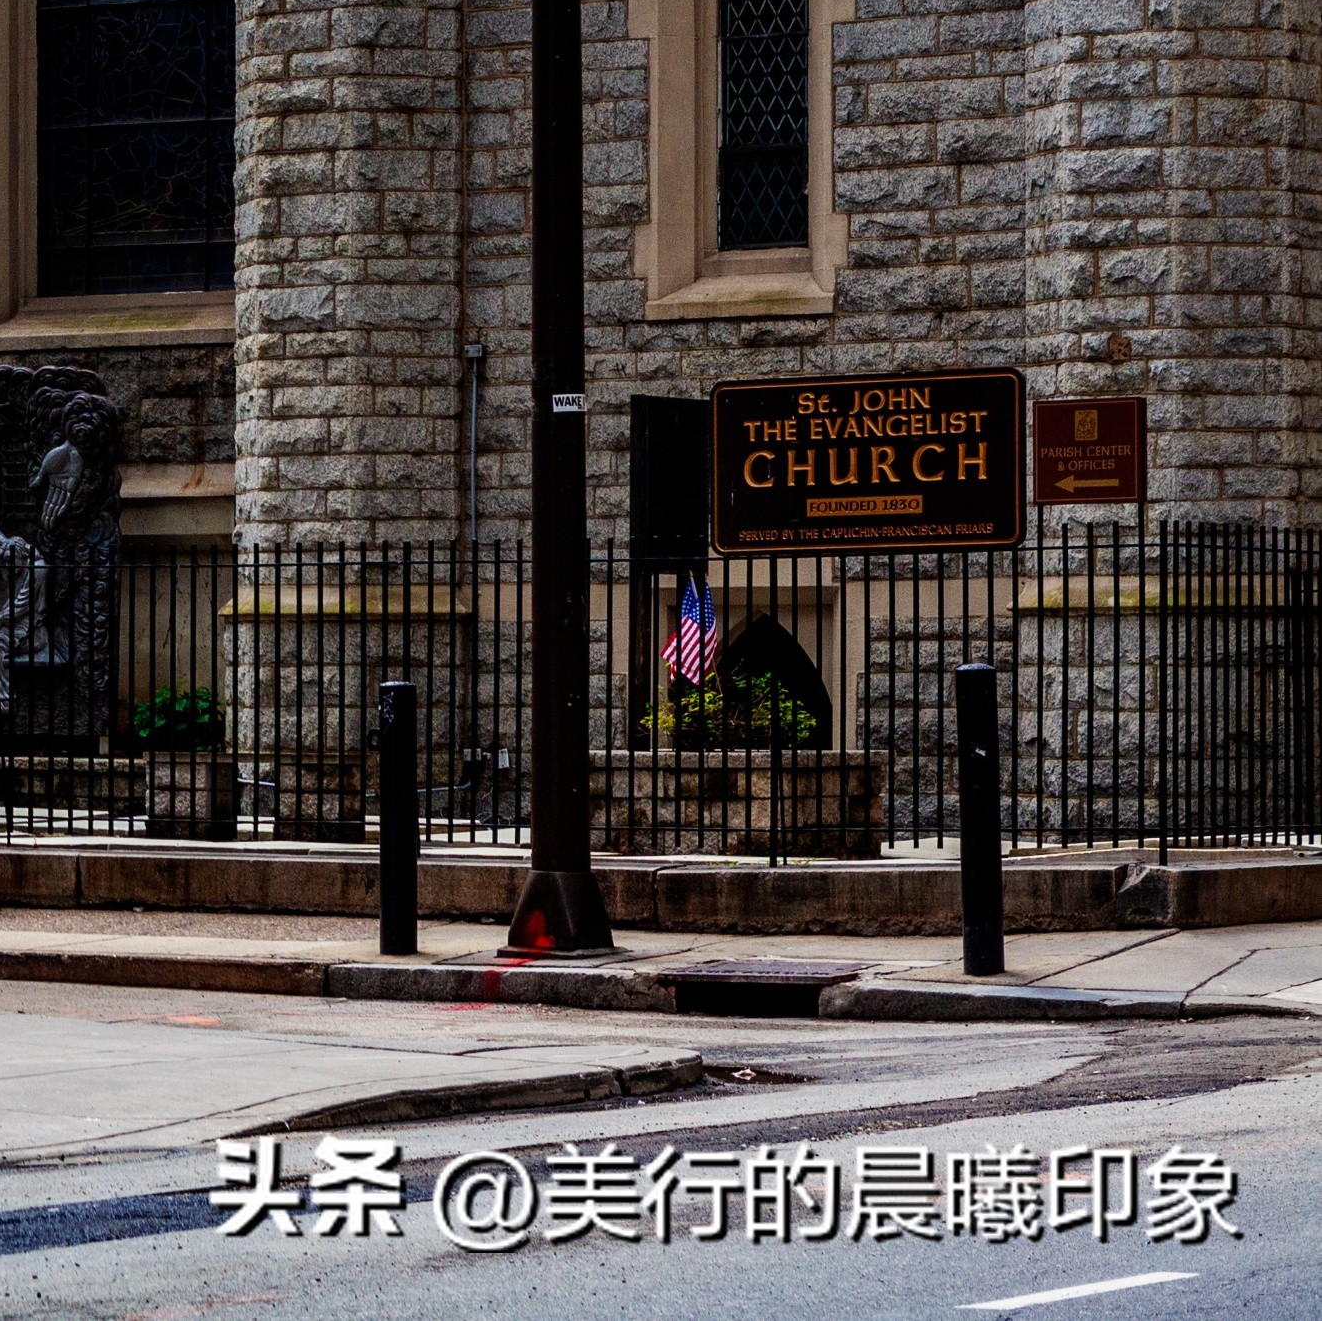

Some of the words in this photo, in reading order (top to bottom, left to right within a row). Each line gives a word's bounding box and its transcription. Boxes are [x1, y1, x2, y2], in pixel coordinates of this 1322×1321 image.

[797, 392, 838, 414] St.
[849, 387, 931, 415] JOHN
[743, 419, 798, 442] THE
[810, 410, 988, 440] EVANGELIST
[1040, 446, 1083, 458] PARISH
[1086, 444, 1131, 457] CENTER
[743, 442, 988, 488] CHURCH
[1057, 460, 1065, 471] &
[1068, 458, 1116, 471] OFFICES
[809, 500, 877, 513] FOUNDED
[882, 498, 920, 511] 1830
[739, 529, 778, 542] SERVED
[782, 530, 794, 540] BY
[800, 528, 819, 540] THE
[823, 525, 952, 539] CAPUCHIN-FRANCISCAN
[956, 522, 994, 535] FRIARS
